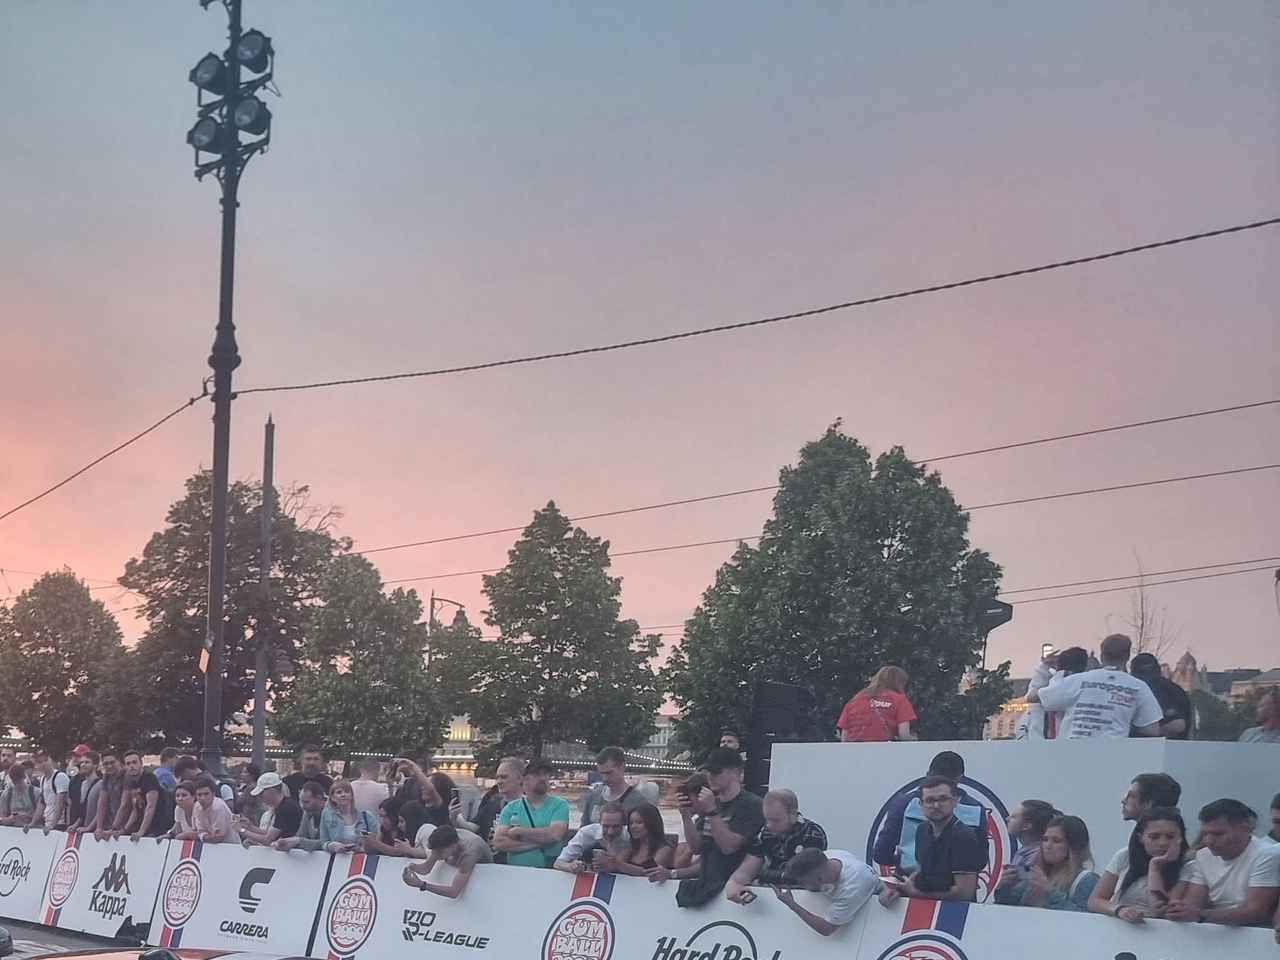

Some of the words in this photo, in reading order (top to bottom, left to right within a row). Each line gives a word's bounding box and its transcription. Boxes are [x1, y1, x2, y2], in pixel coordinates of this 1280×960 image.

[1079, 681, 1139, 696] European
[9, 859, 31, 881] Rock
[88, 890, 128, 920] Kappa
[338, 892, 373, 909] GUM
[219, 920, 269, 939] CARRERA
[559, 916, 607, 939] GUM
[552, 935, 605, 958] BALL
